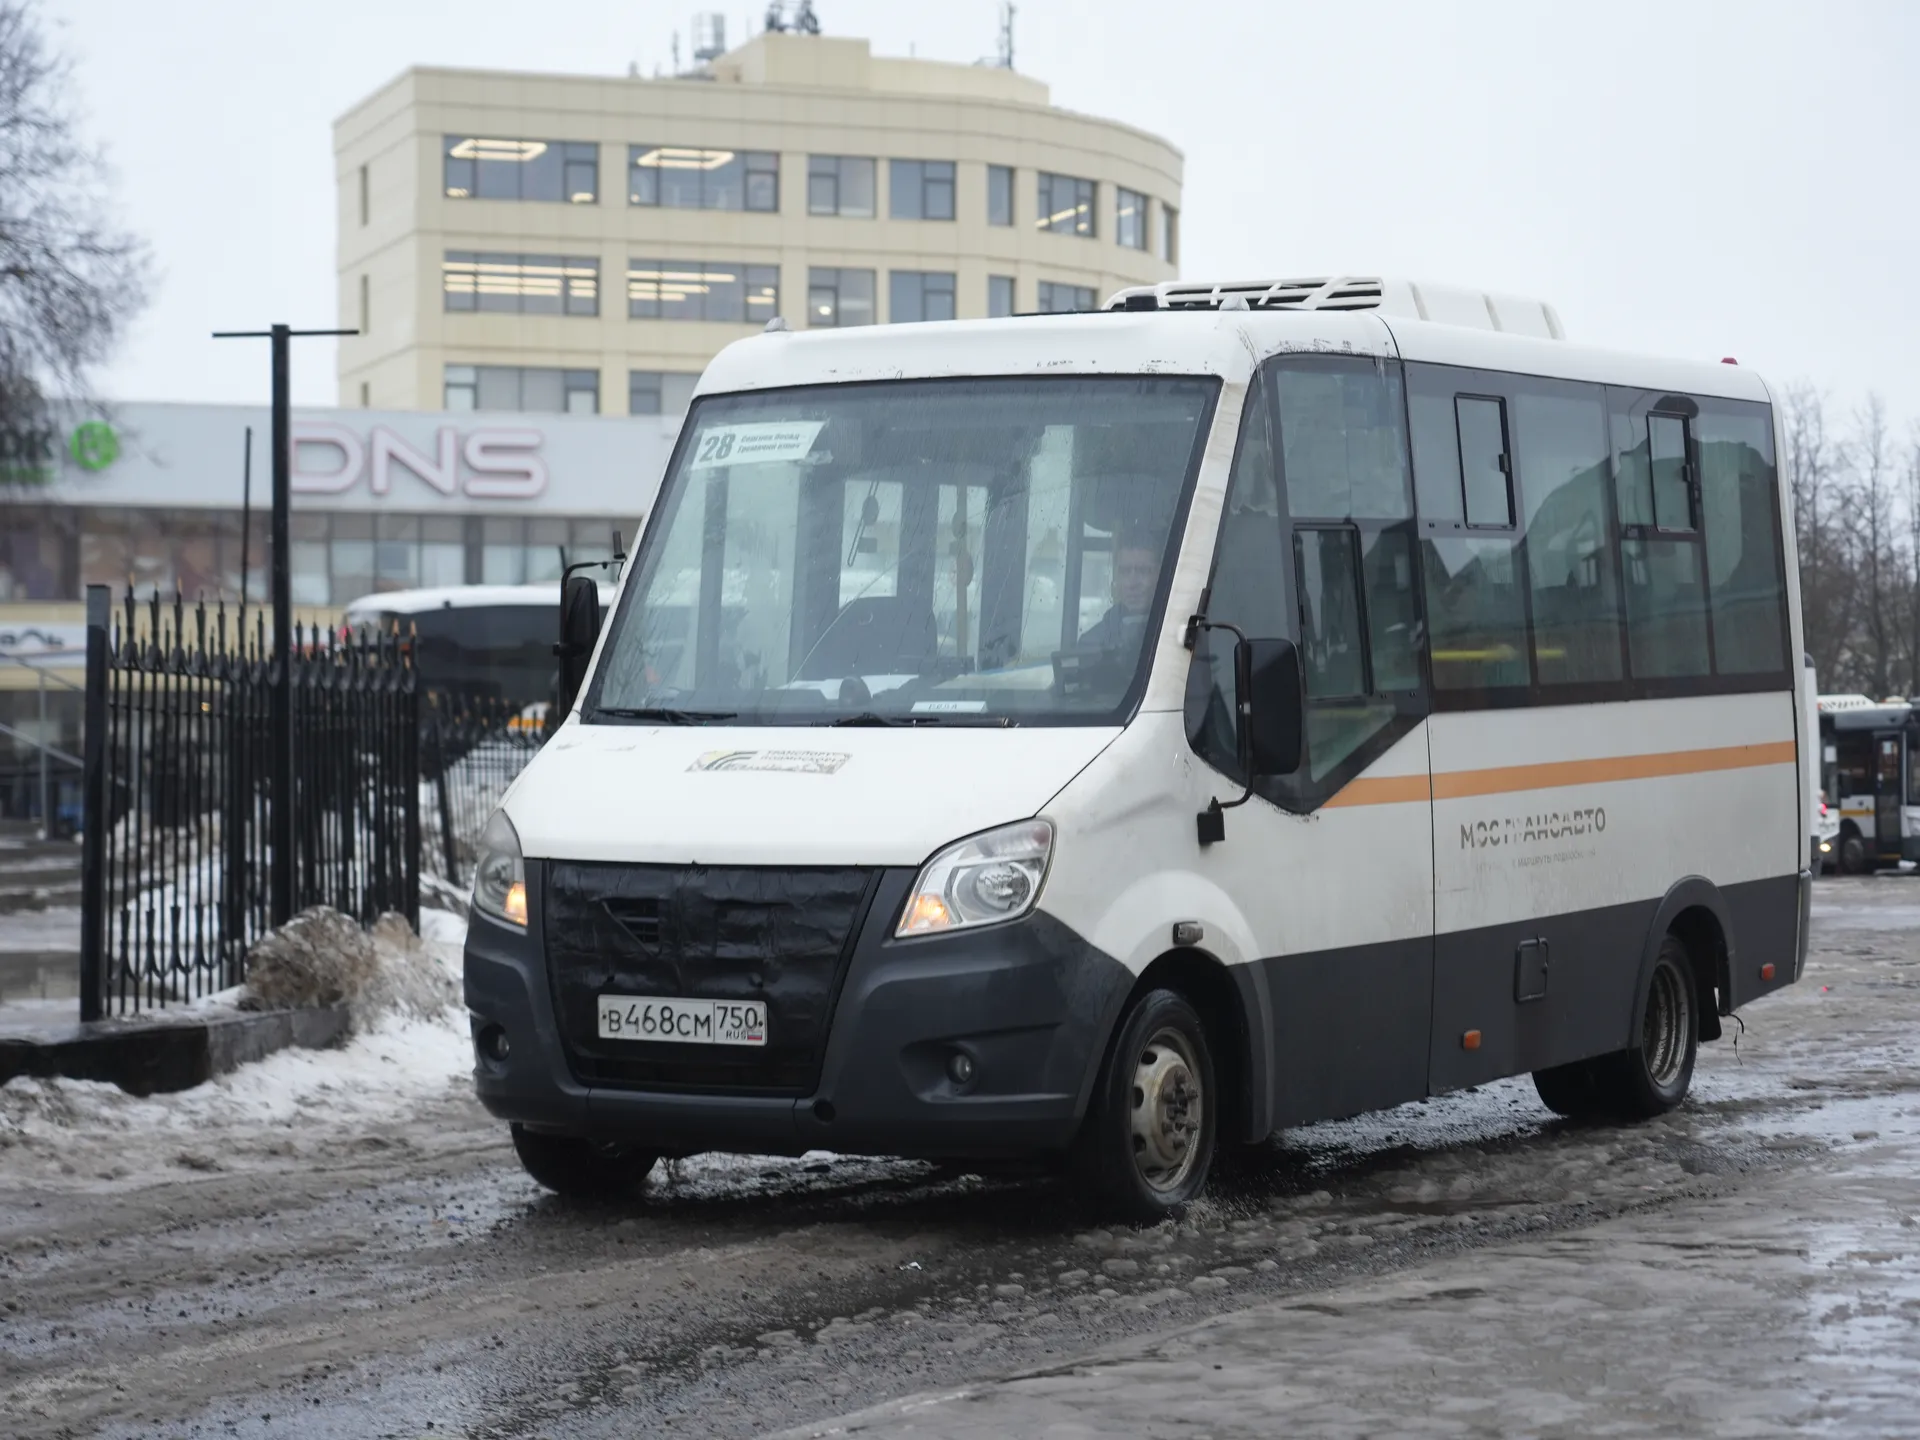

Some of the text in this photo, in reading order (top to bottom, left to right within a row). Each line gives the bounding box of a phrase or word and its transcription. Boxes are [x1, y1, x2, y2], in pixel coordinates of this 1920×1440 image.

[291, 421, 548, 498] DNS
[700, 433, 736, 462] 28
[1460, 806, 1606, 849] МОСТАНСАВТО
[608, 1004, 758, 1038] В468СМ 750
[726, 1030, 746, 1040] RUS
